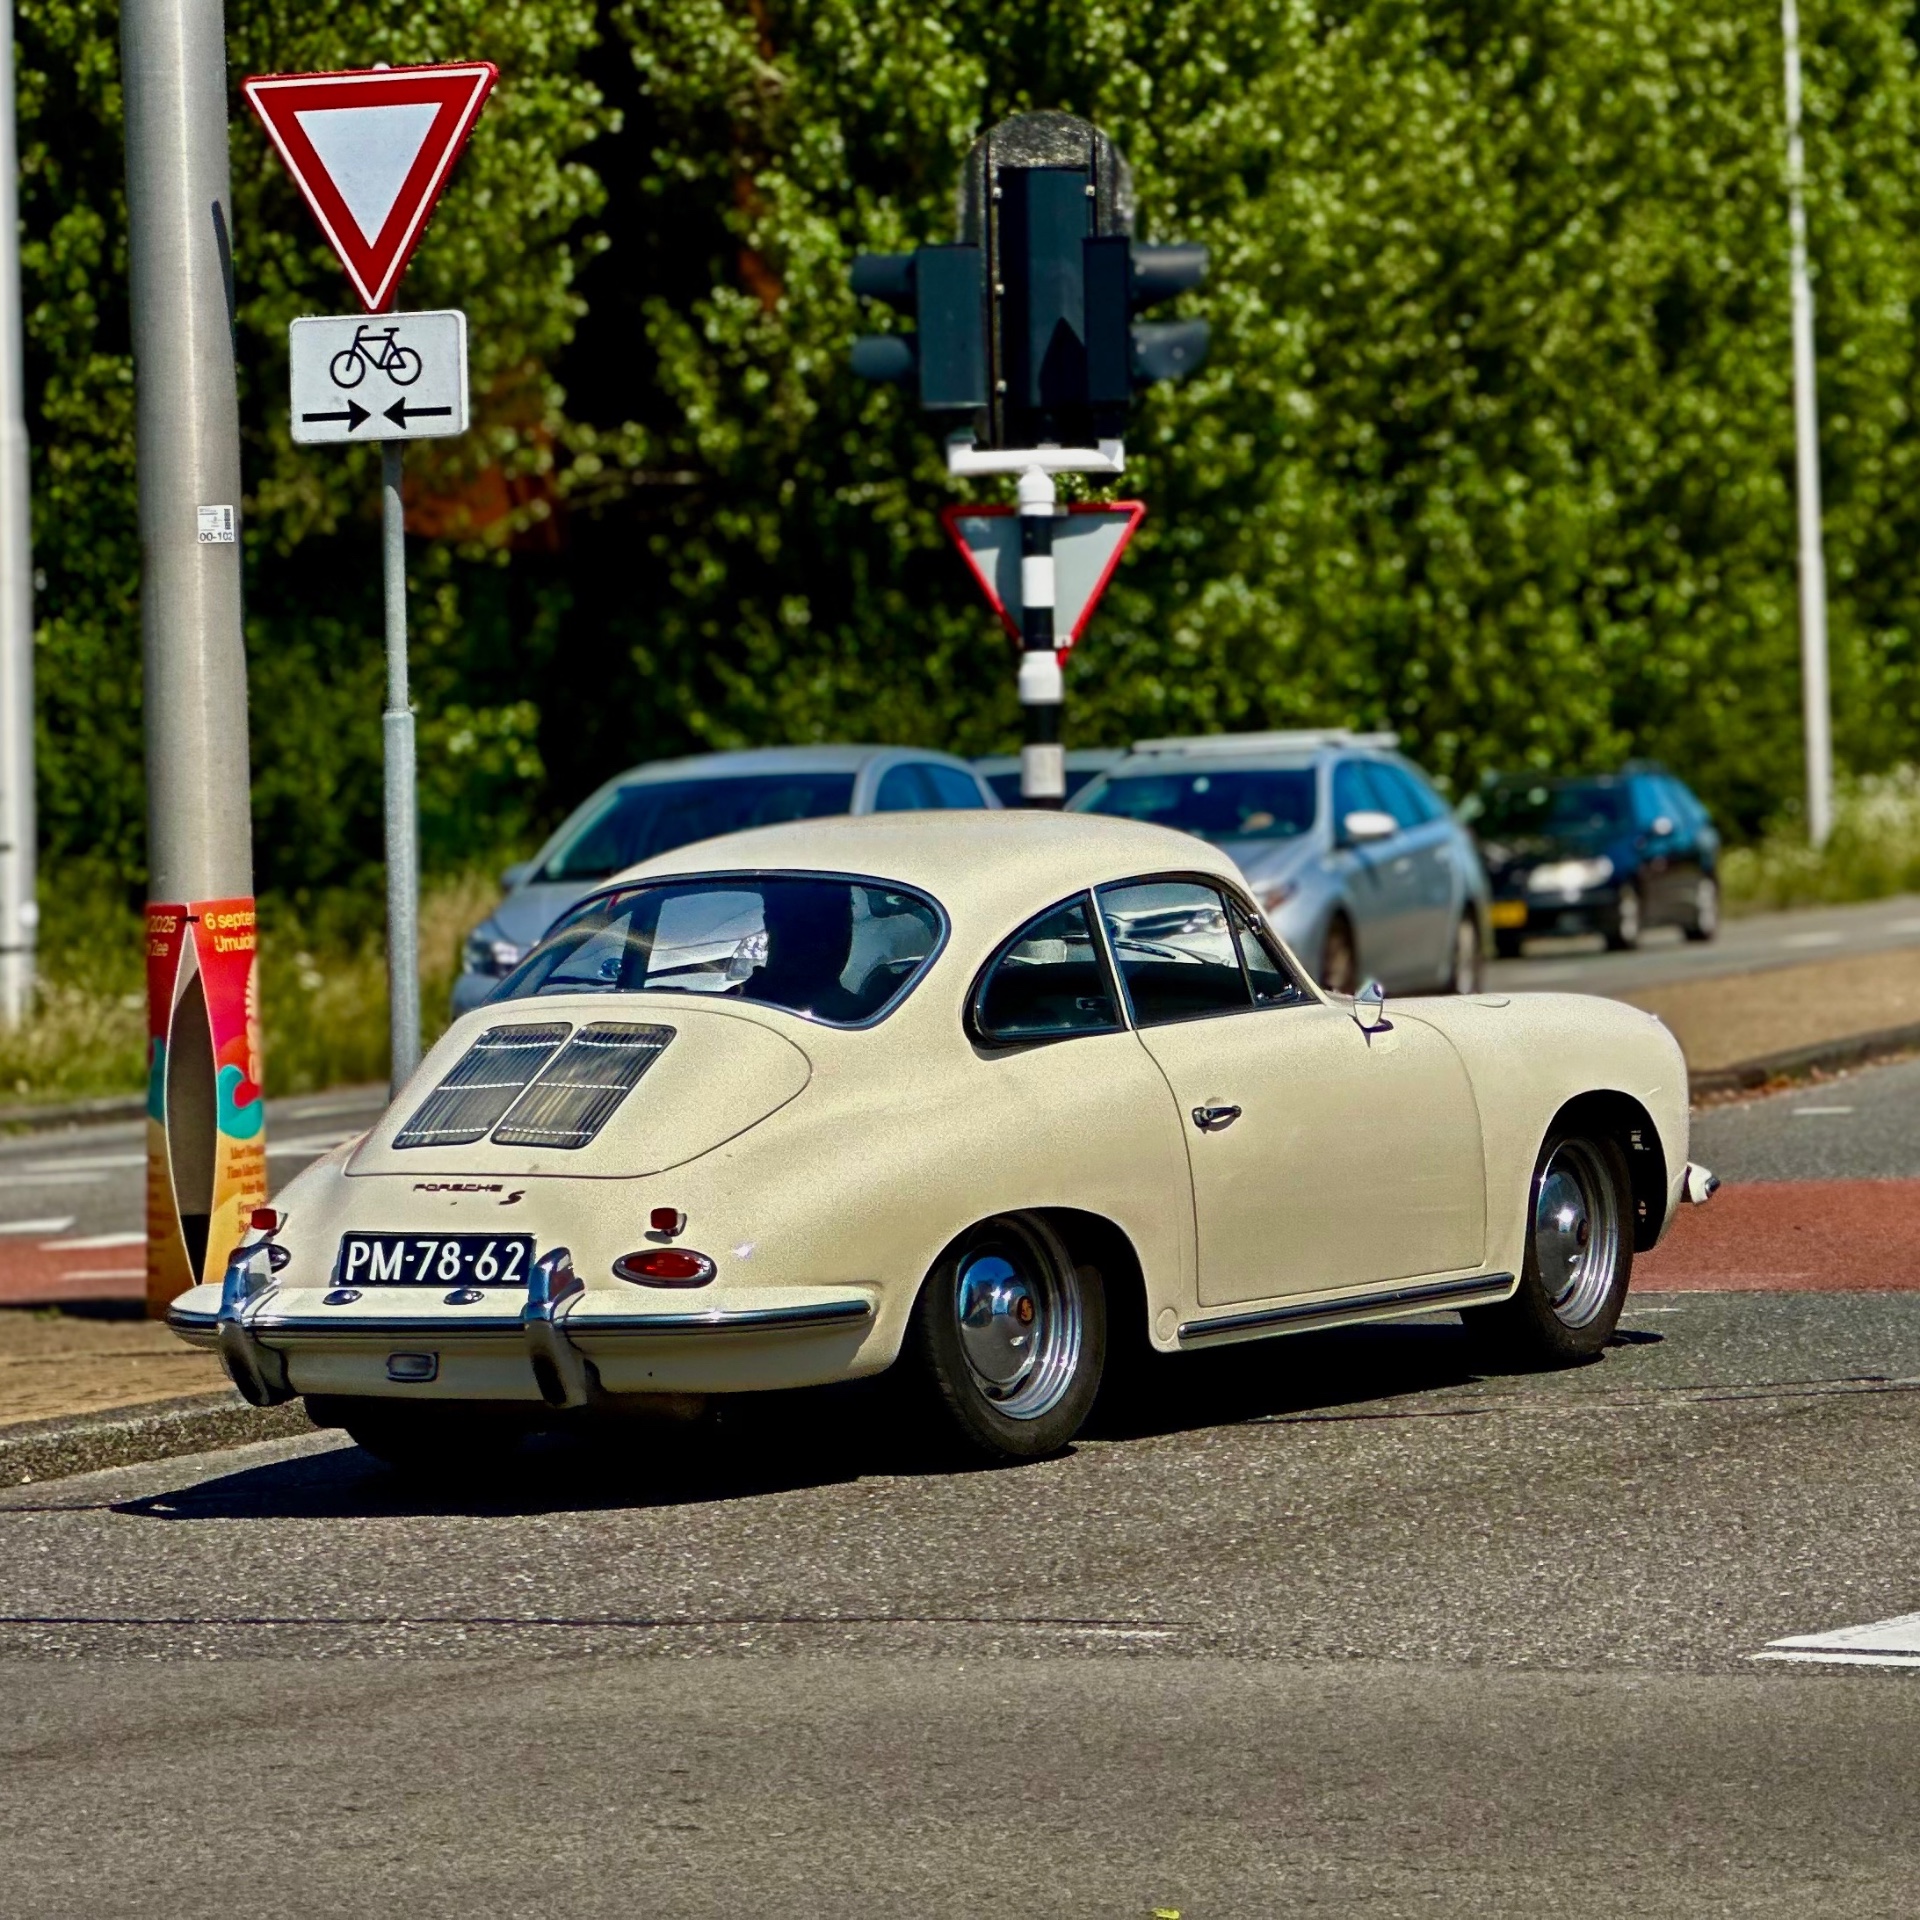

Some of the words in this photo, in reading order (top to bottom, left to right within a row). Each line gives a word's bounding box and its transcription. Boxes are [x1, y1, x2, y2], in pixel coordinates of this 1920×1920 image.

[205, 912, 217, 930] 6
[413, 1184, 503, 1192] PORSCHE
[499, 1190, 526, 1205] S
[345, 1241, 525, 1281] PM-78-62
